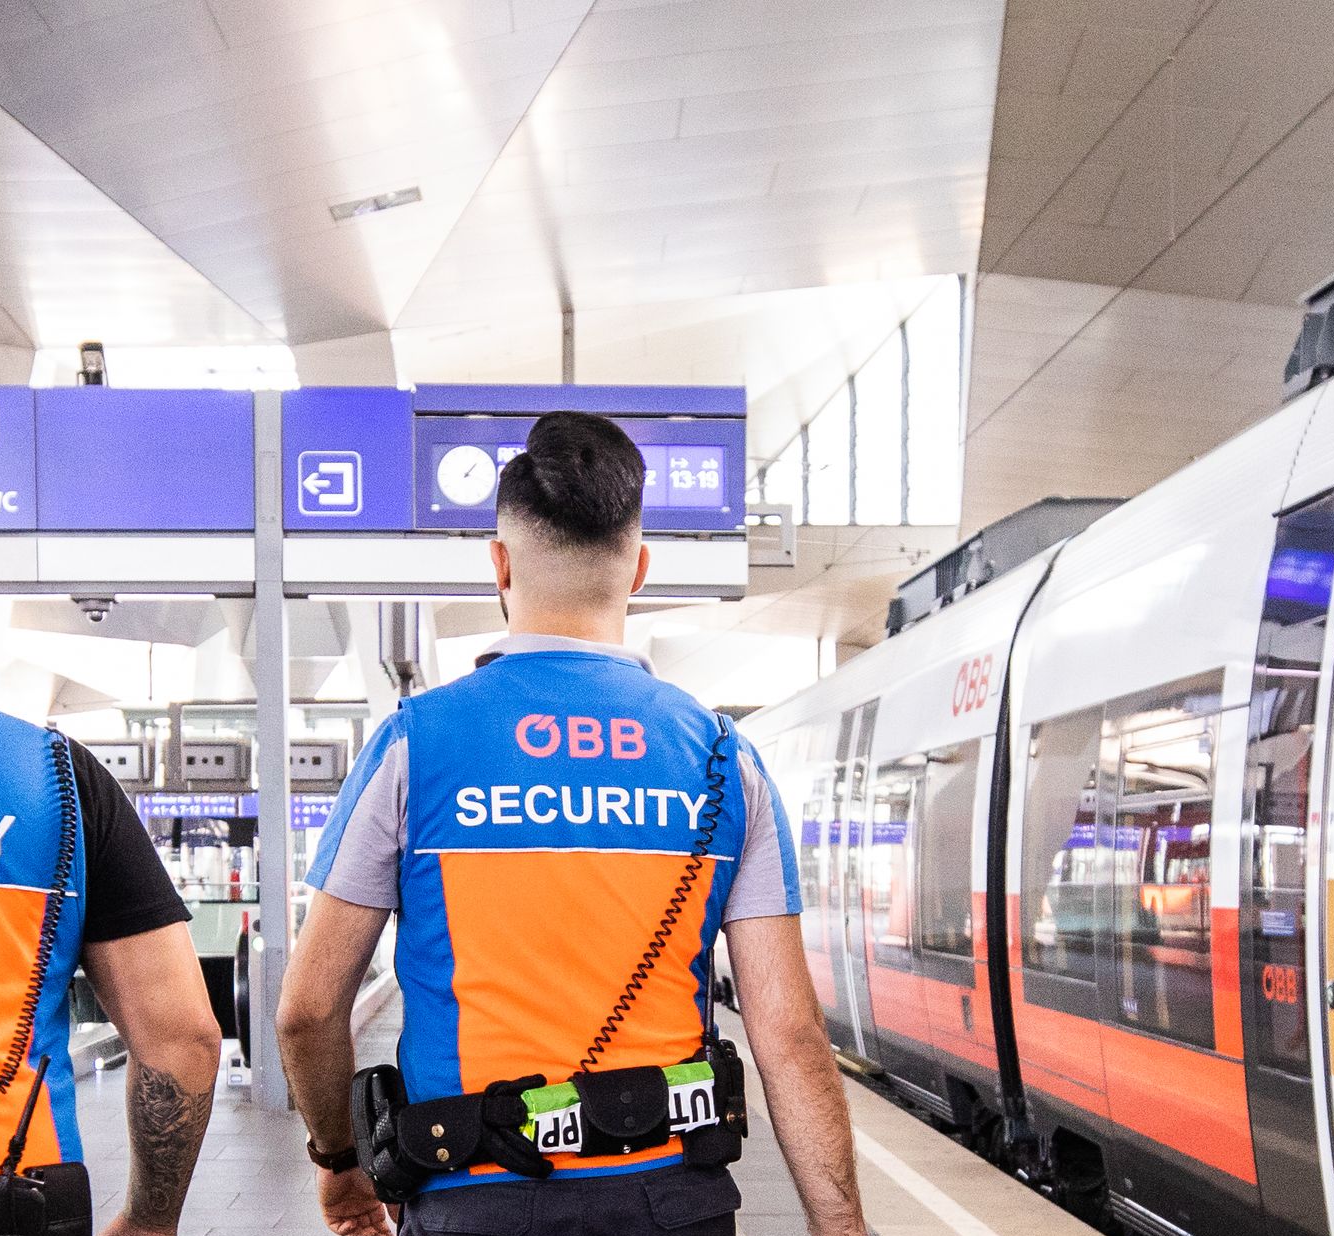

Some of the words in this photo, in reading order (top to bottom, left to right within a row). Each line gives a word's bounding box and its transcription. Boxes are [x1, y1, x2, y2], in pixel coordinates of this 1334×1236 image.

[670, 470, 719, 489] 13:19
[952, 653, 993, 717] ÖBB
[516, 713, 647, 760] ÖBB
[456, 784, 708, 830] SECURITY
